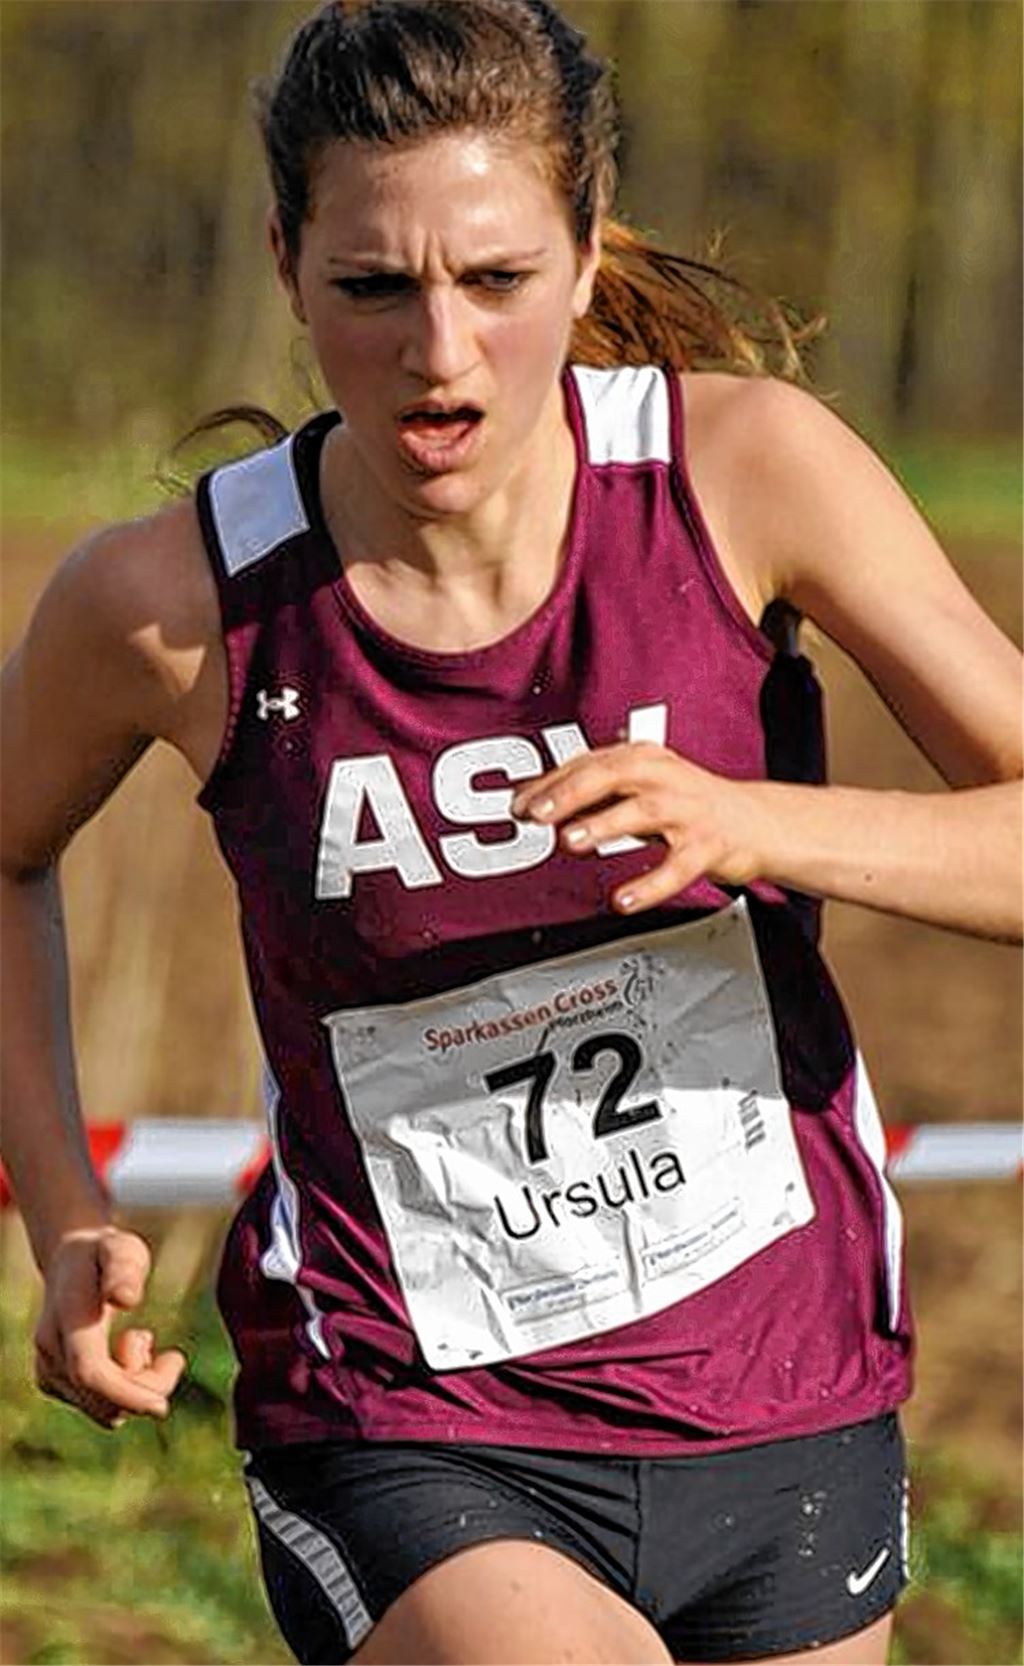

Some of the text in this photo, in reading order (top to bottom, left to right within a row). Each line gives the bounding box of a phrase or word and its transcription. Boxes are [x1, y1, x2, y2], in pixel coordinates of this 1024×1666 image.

[424, 978, 618, 1052] Sparkassen Cross
[484, 1034, 662, 1163] 72
[494, 1149, 687, 1240] Ursula
